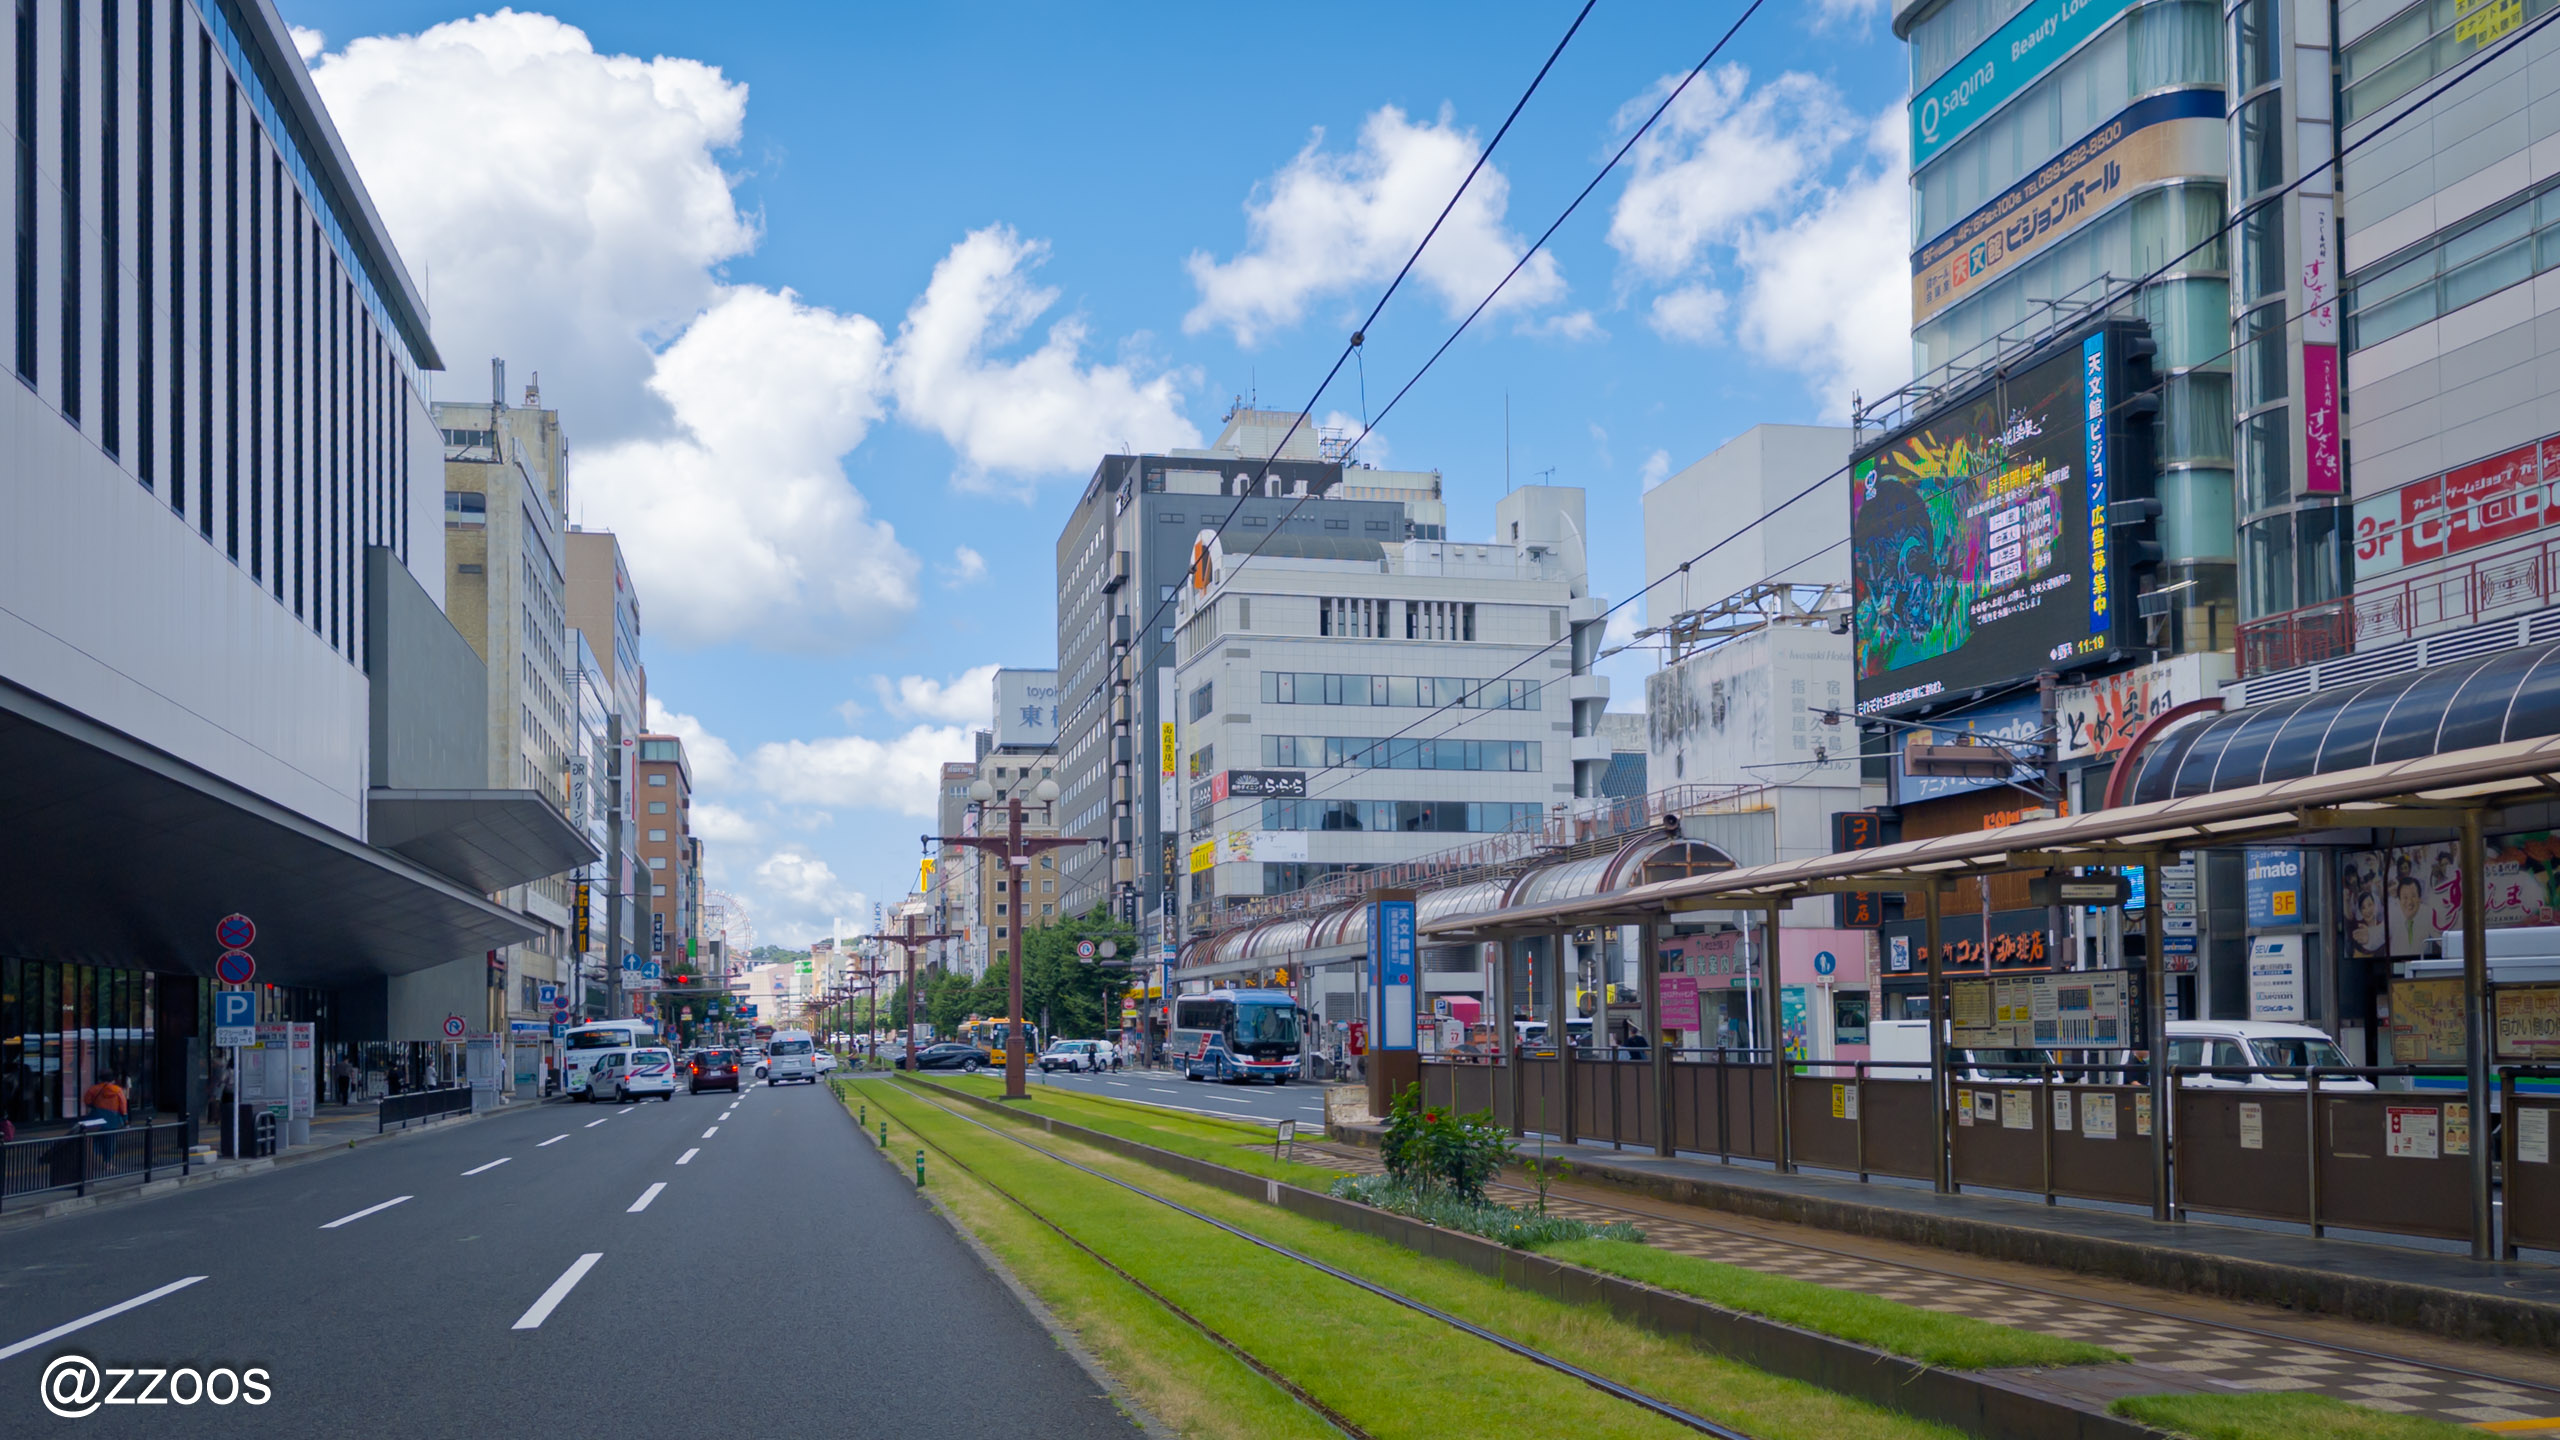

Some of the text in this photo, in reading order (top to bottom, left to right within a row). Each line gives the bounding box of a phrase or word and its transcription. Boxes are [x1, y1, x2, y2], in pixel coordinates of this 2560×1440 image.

[2010, 13, 2059, 62] Beauty
[2356, 517, 2397, 560] 3F
[2274, 895, 2296, 913] 3F
[226, 995, 248, 1024] P
